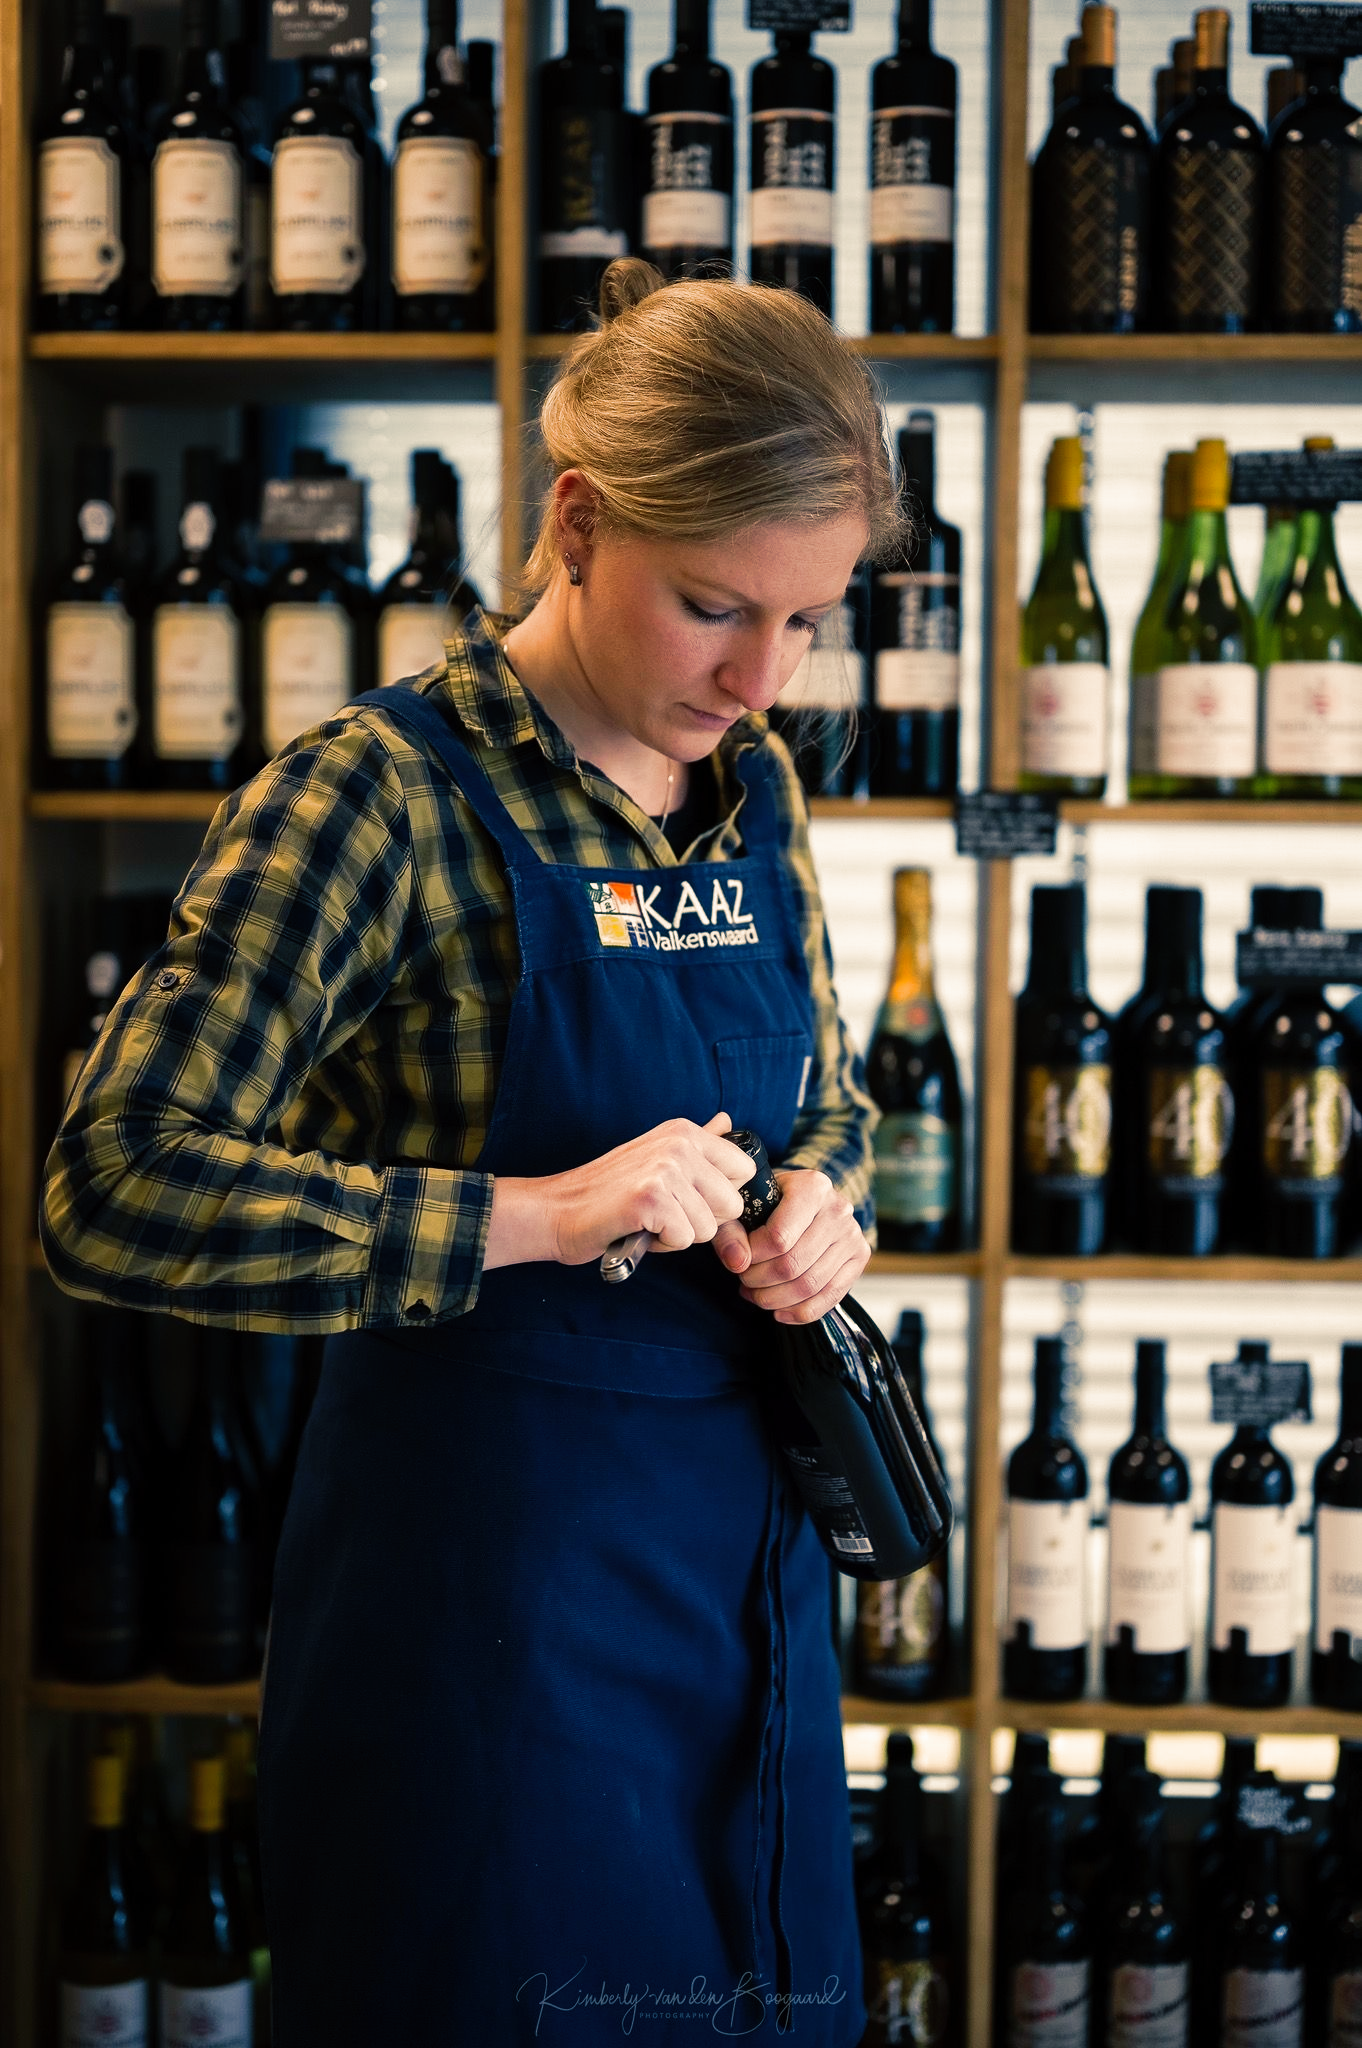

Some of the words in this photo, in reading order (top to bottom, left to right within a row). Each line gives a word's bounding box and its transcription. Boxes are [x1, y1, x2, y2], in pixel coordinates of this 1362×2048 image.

[636, 878, 754, 930] KAAZ
[648, 922, 760, 951] Valkenswaard
[1151, 1080, 1236, 1161] 40
[1265, 1080, 1352, 1162] 40
